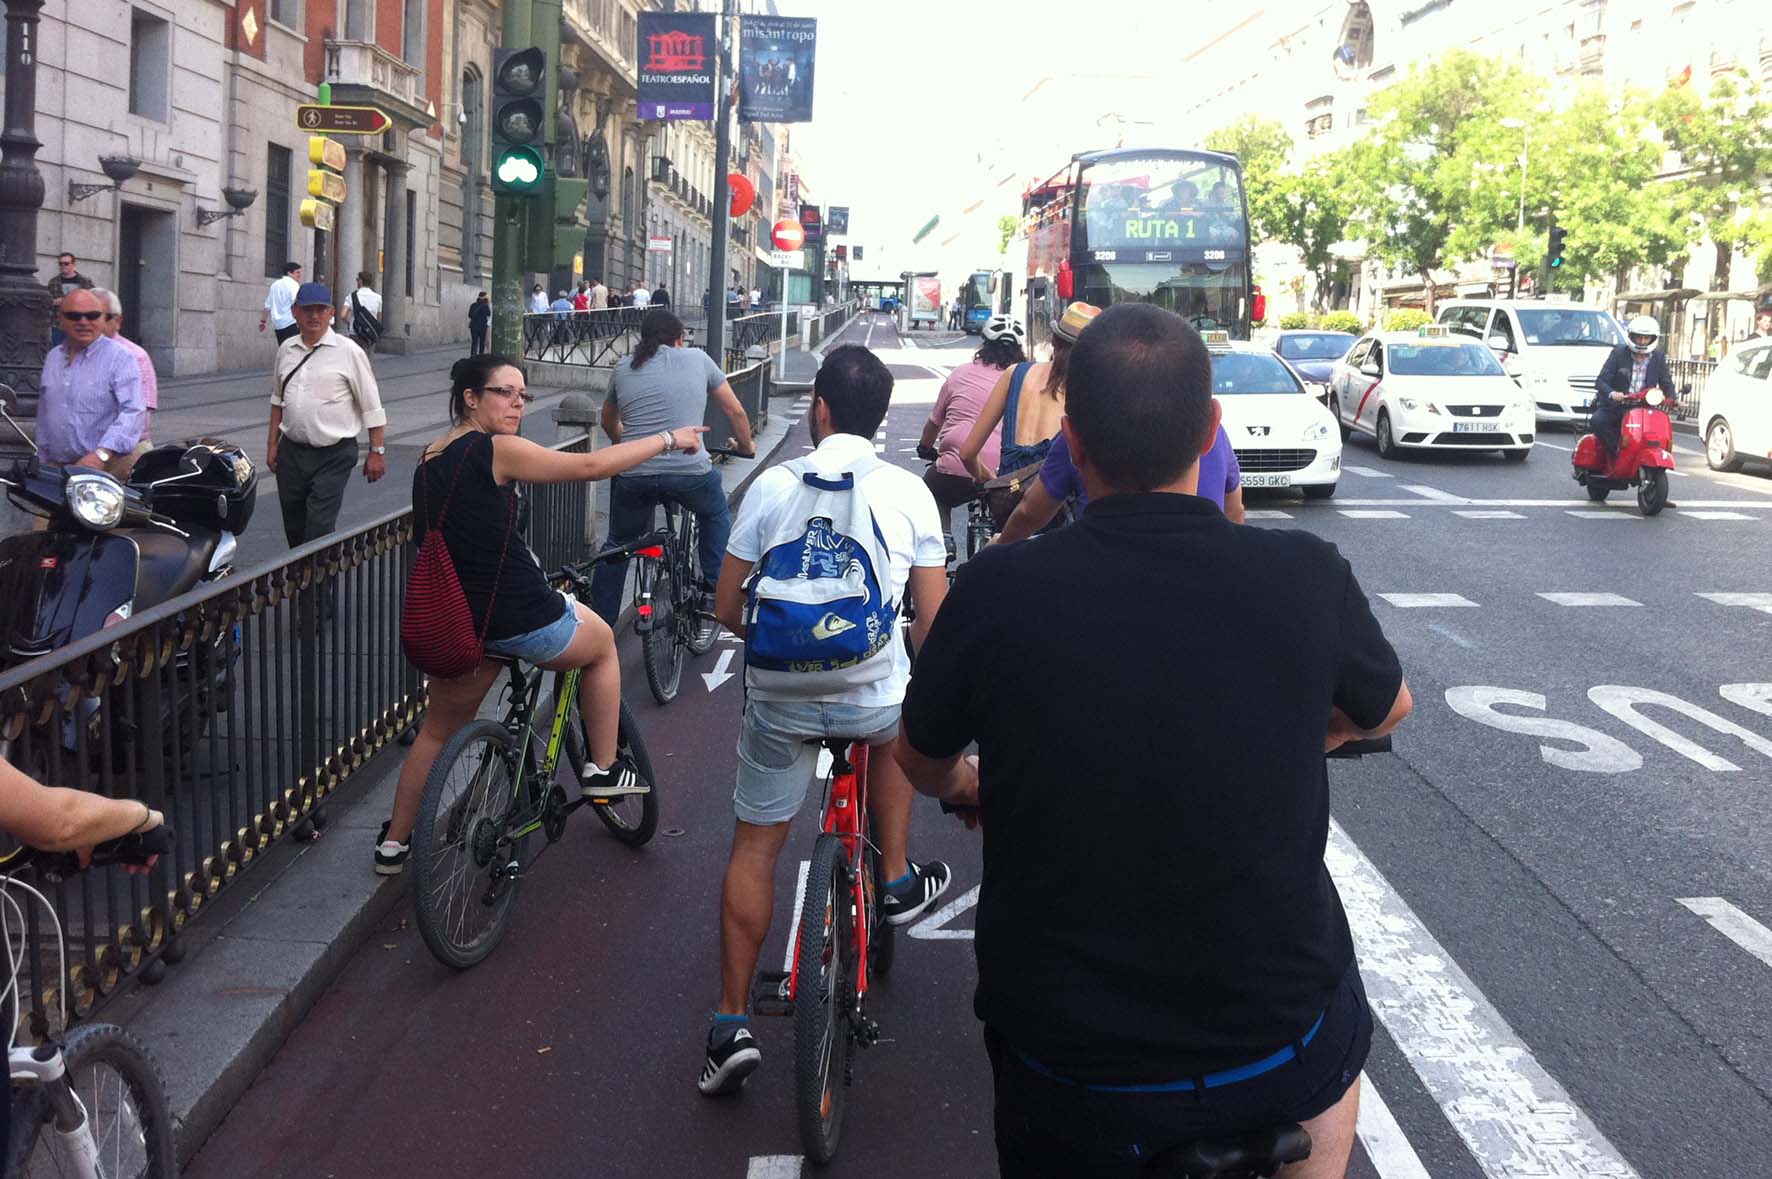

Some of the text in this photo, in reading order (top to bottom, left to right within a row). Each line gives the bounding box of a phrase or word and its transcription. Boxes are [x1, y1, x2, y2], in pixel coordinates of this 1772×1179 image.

[1125, 219, 1195, 238] RUTA 1
[1268, 476, 1287, 486] GKC
